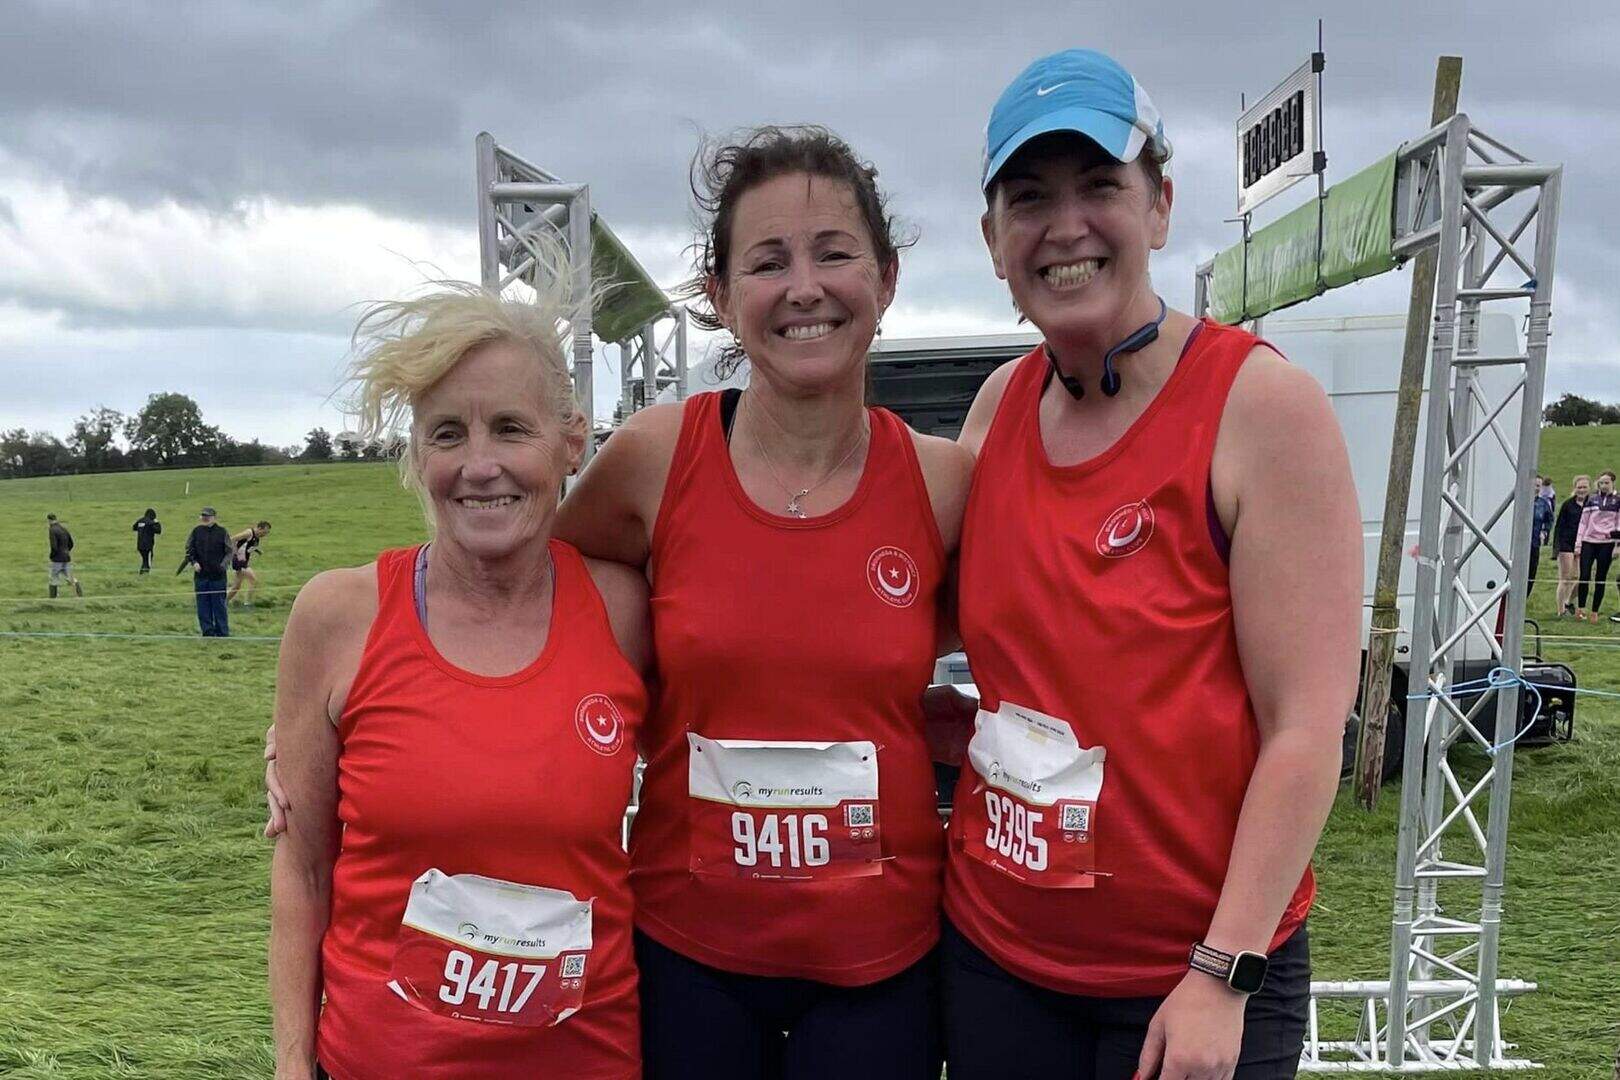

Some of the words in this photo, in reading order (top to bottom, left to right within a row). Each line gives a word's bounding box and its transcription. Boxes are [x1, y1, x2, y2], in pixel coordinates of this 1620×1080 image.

[758, 786, 823, 798] myrunresults
[731, 812, 830, 868] 9416
[985, 791, 1048, 872] 9395
[483, 934, 546, 948] myrunresults
[439, 950, 547, 1013] 9417
